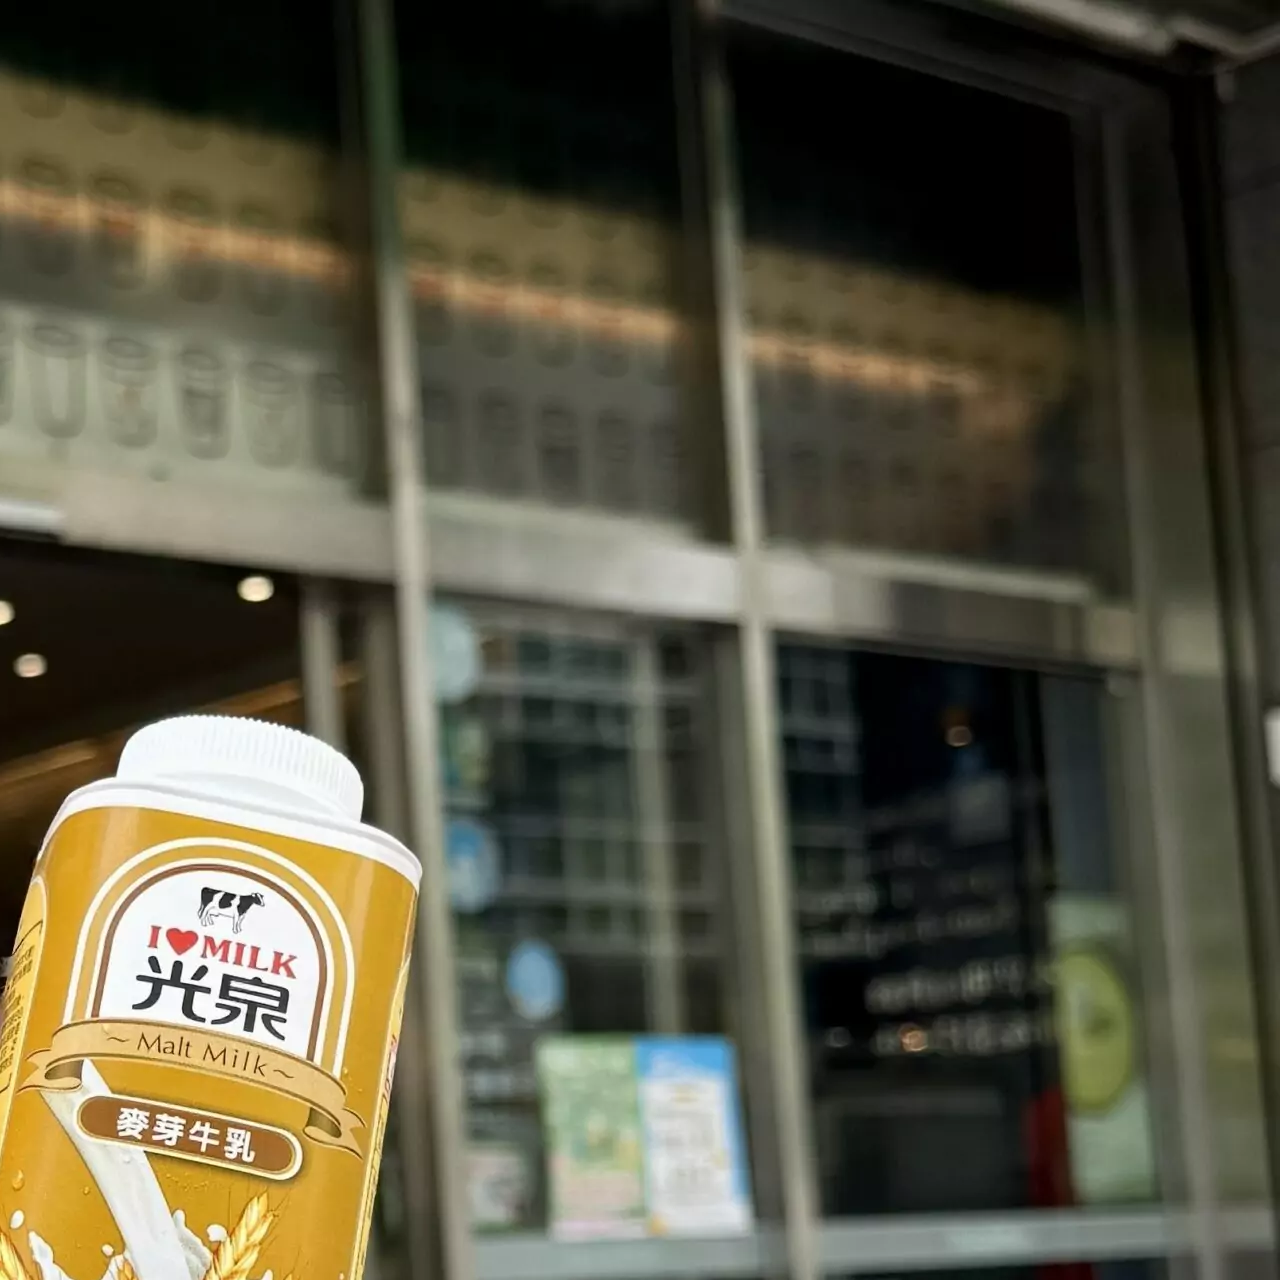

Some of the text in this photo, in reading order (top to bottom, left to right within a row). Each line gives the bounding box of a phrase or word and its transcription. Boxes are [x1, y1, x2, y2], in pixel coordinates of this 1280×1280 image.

[147, 925, 299, 979] I MILK
[131, 956, 291, 1041] 光泉
[137, 1032, 268, 1077] Malt Milk
[116, 1107, 256, 1163] 麥芽牛乳
